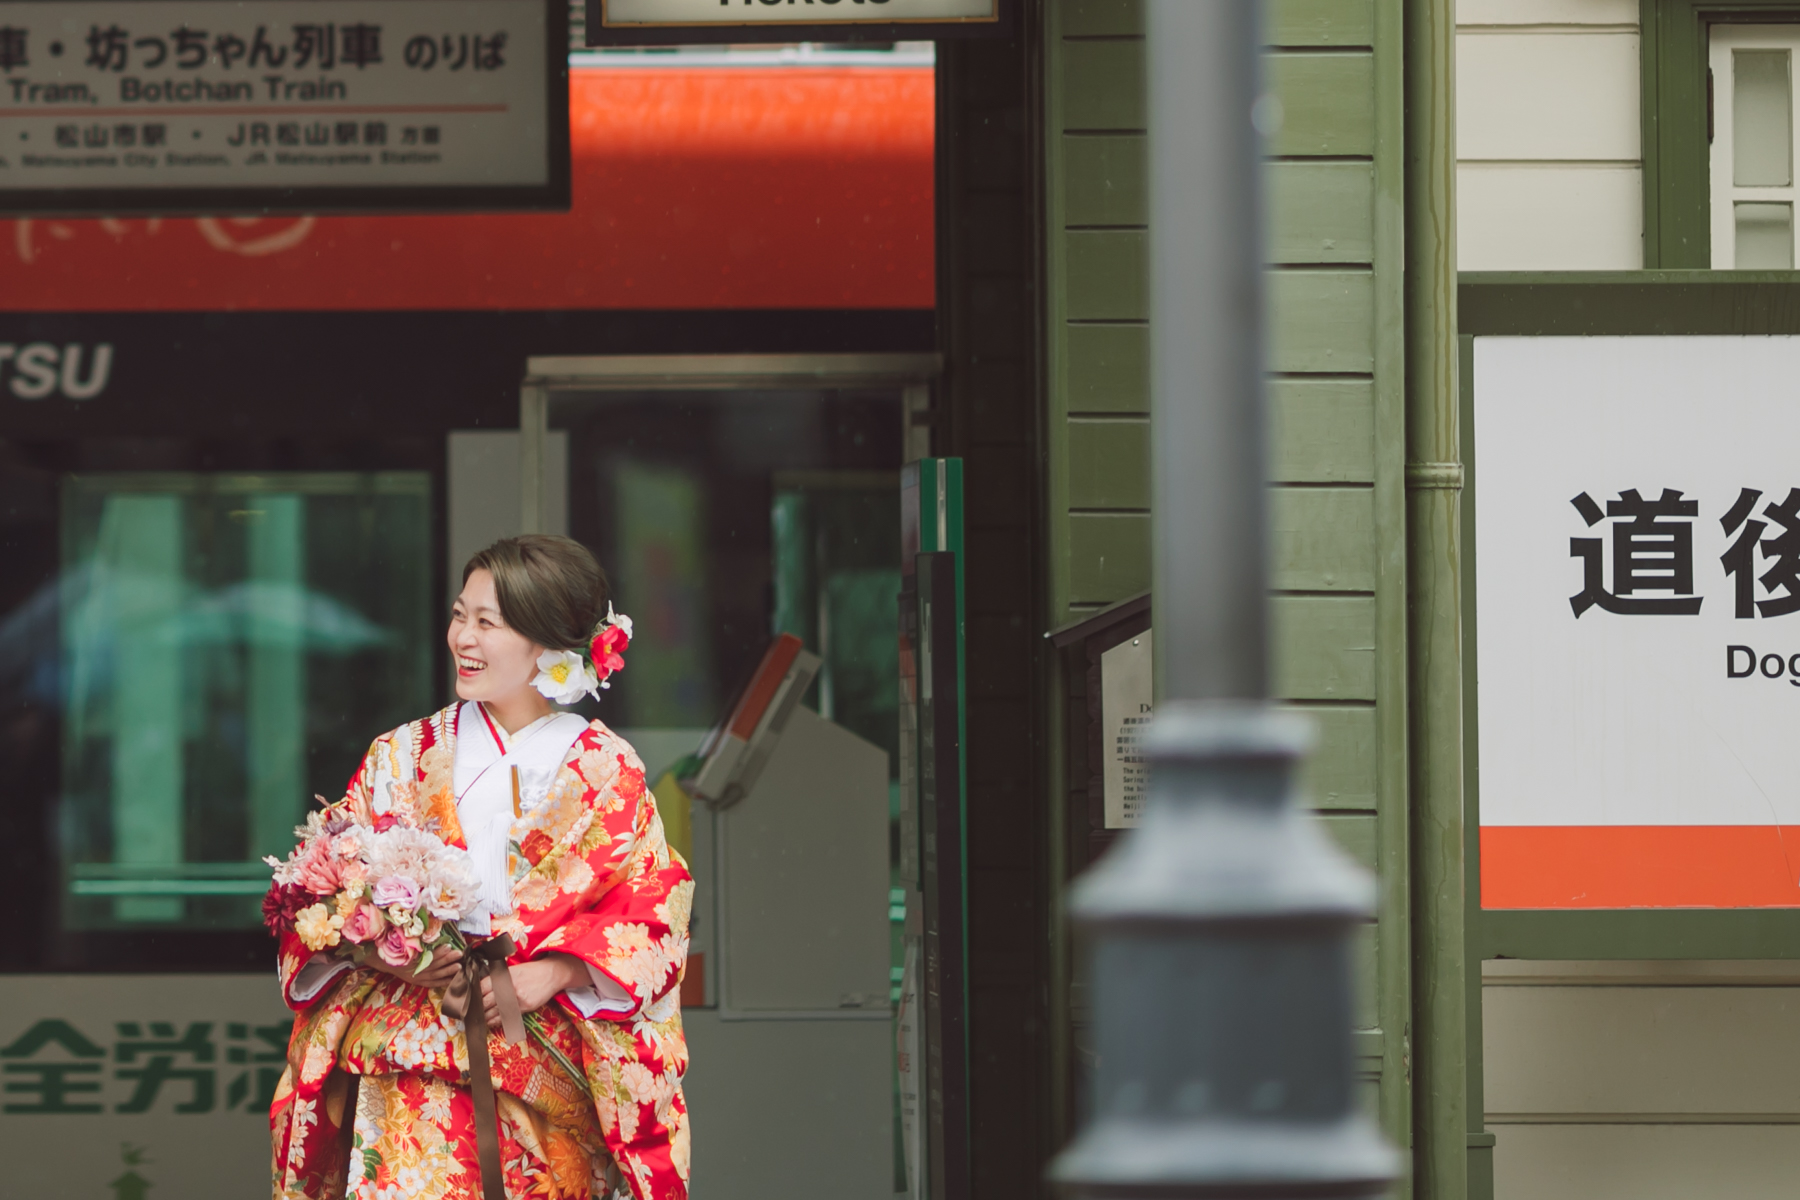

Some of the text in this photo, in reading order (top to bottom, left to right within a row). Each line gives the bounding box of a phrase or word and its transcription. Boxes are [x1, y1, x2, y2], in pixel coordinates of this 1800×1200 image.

[403, 31, 508, 70] のりば
[7, 75, 347, 105] Tram, Botchan Train
